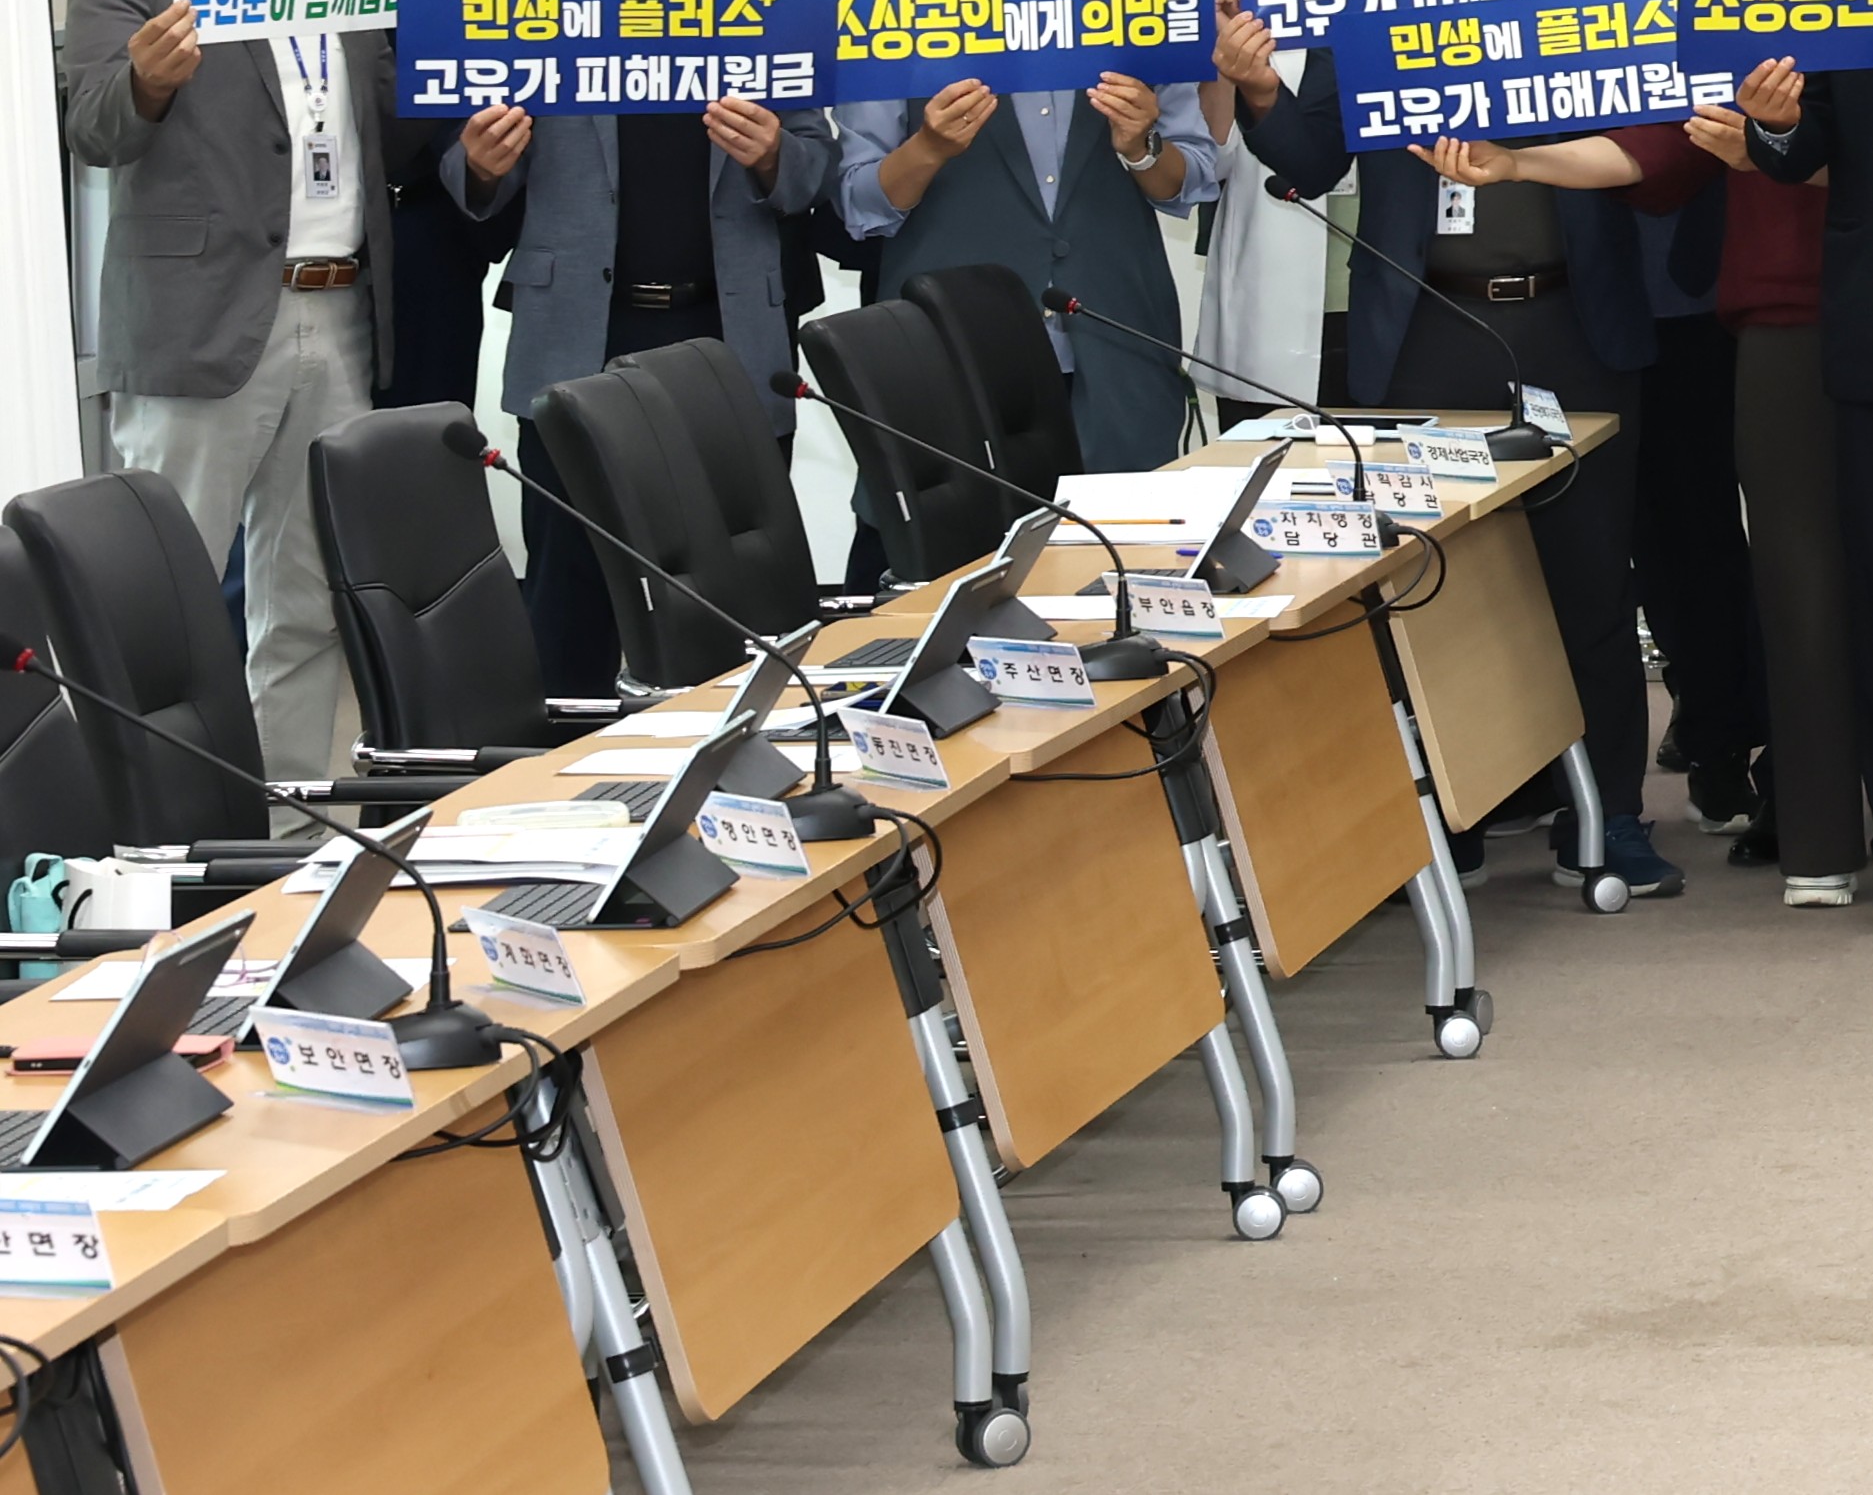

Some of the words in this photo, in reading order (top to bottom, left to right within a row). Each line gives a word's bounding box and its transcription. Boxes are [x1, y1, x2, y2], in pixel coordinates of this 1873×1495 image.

[1390, 18, 1522, 69] 민생에
[414, 58, 560, 106] 고유가
[576, 53, 813, 101] 피해지원금
[1357, 82, 1490, 138] 고유가
[1504, 62, 1733, 126] 피해지원금
[297, 1042, 403, 1081] 보안면장
